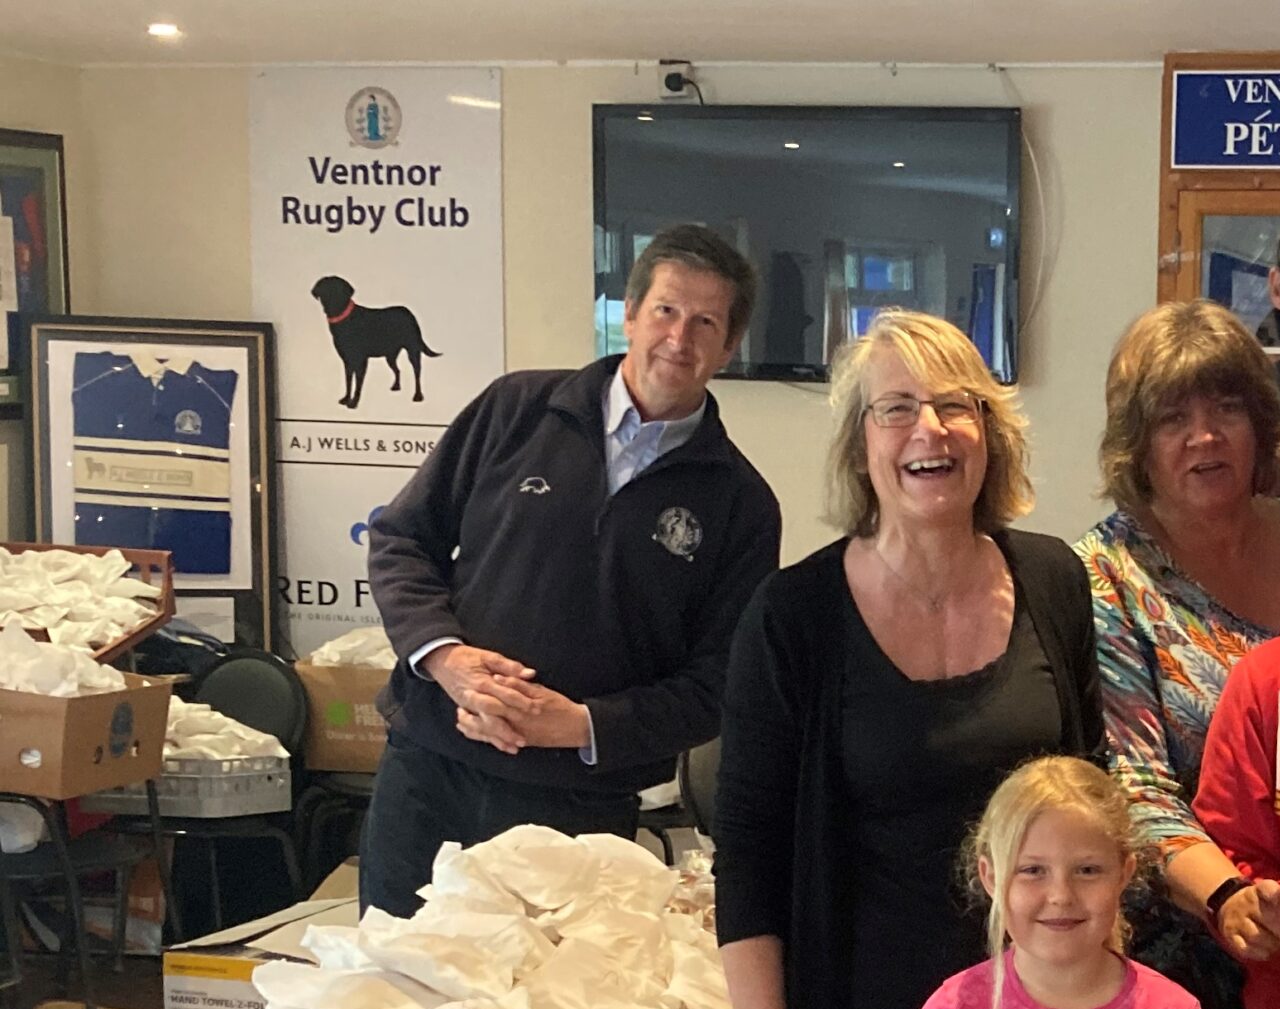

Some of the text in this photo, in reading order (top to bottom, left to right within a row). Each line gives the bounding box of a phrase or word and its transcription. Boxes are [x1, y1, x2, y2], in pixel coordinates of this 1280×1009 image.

[308, 156, 442, 186] Ventnor
[282, 196, 470, 234] Rugby Club
[318, 437, 370, 451] WELLS
[376, 440, 387, 452] &
[393, 440, 435, 454] SONS
